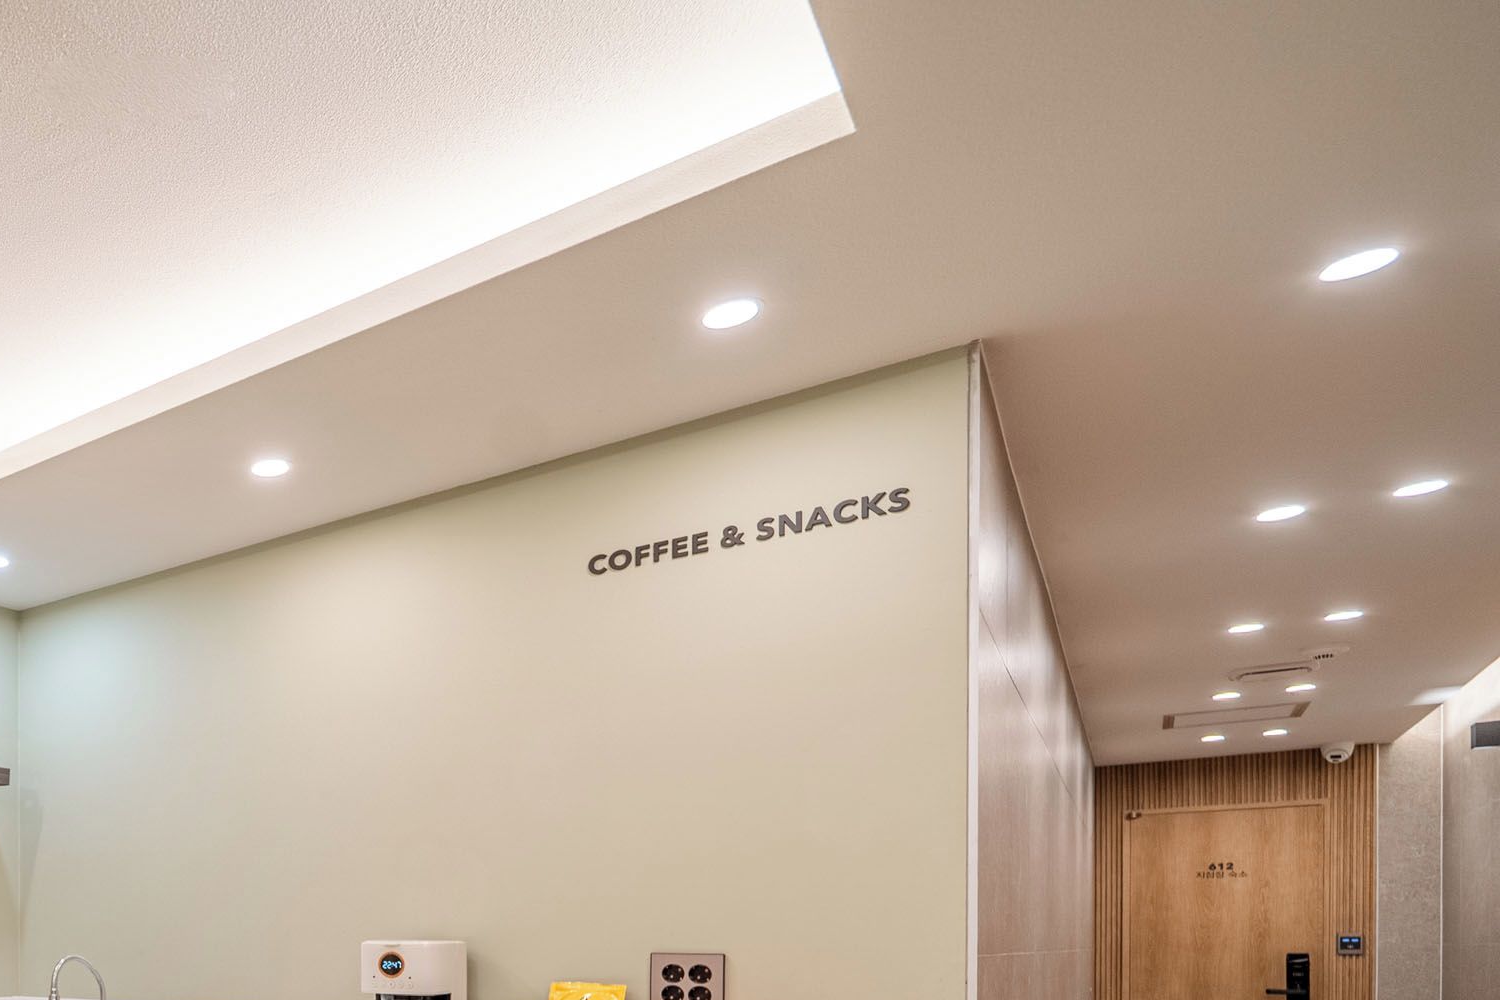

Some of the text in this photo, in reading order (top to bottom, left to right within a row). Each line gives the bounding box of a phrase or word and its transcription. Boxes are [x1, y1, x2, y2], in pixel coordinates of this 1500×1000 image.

[587, 487, 911, 575] COFFEE & SNACKS
[1208, 862, 1234, 870] 612
